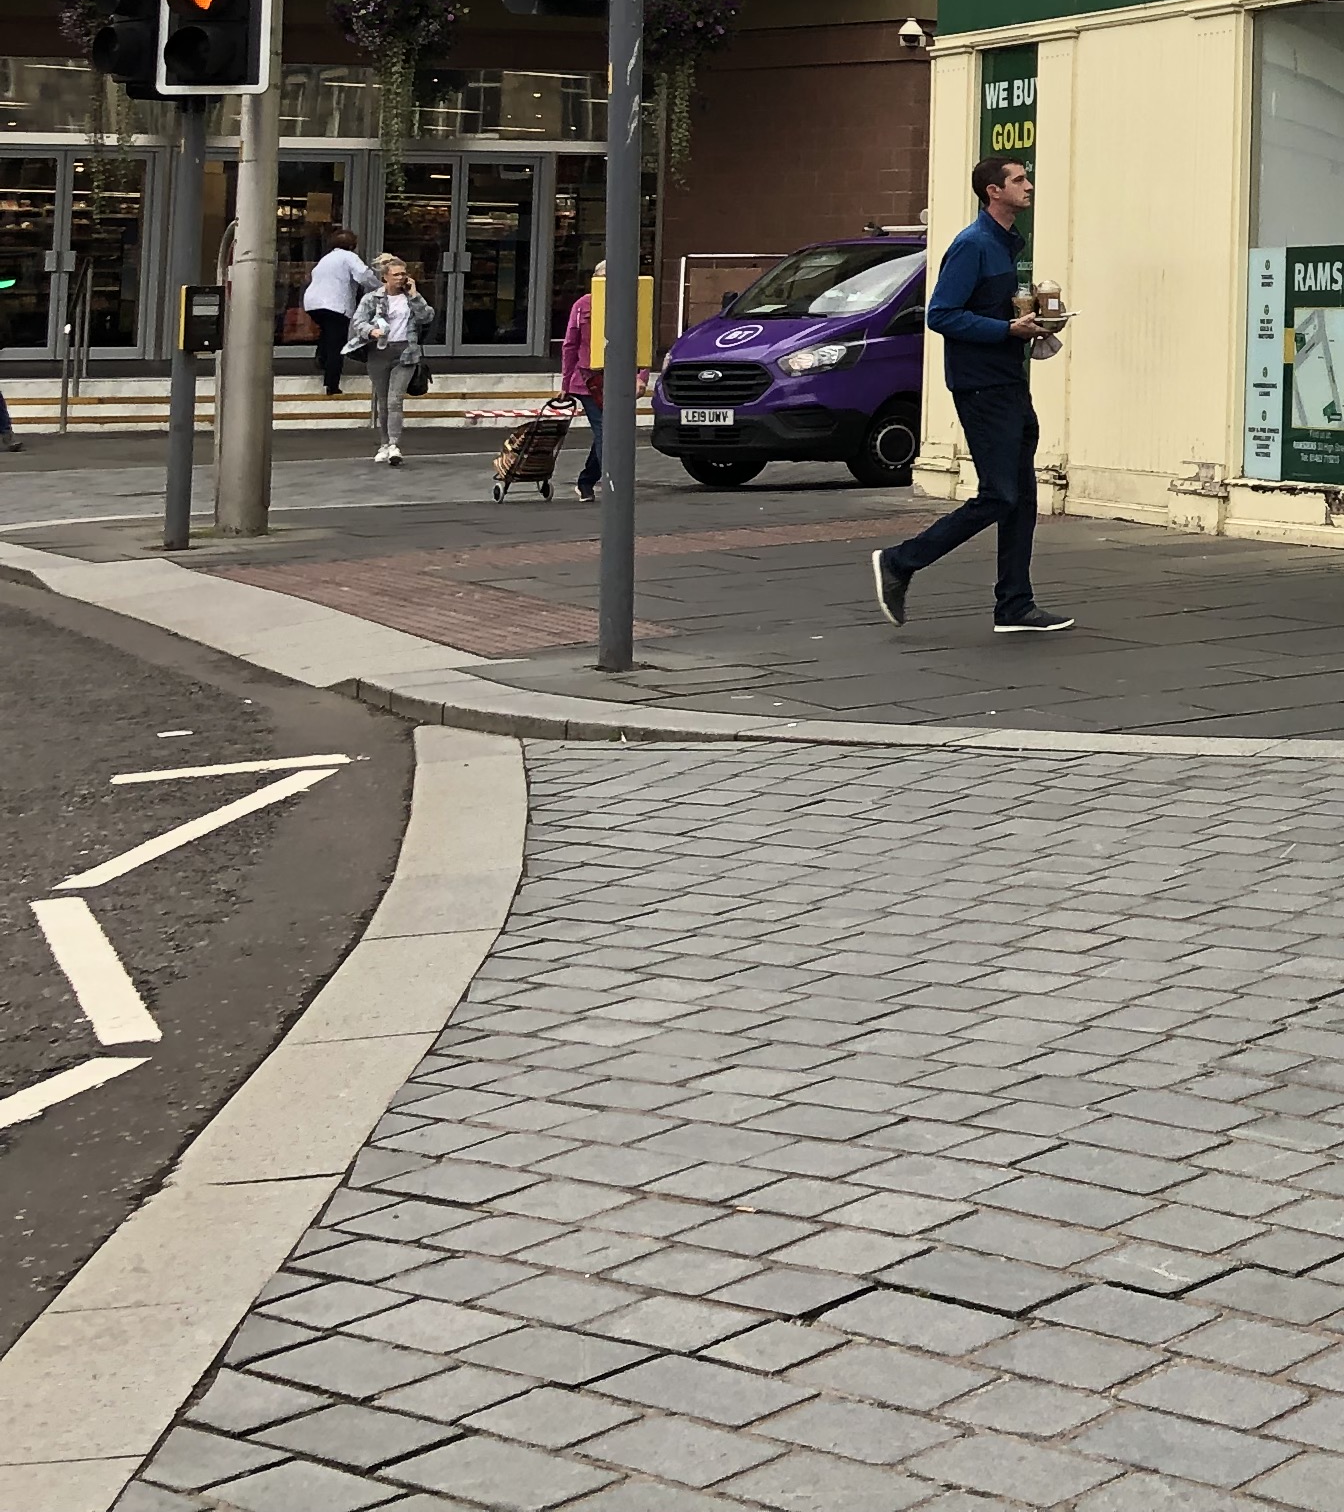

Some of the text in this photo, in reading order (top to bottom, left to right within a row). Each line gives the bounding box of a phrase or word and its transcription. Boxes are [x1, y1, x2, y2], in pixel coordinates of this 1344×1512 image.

[985, 77, 1037, 109] WE BU
[992, 121, 1035, 151] GOLD
